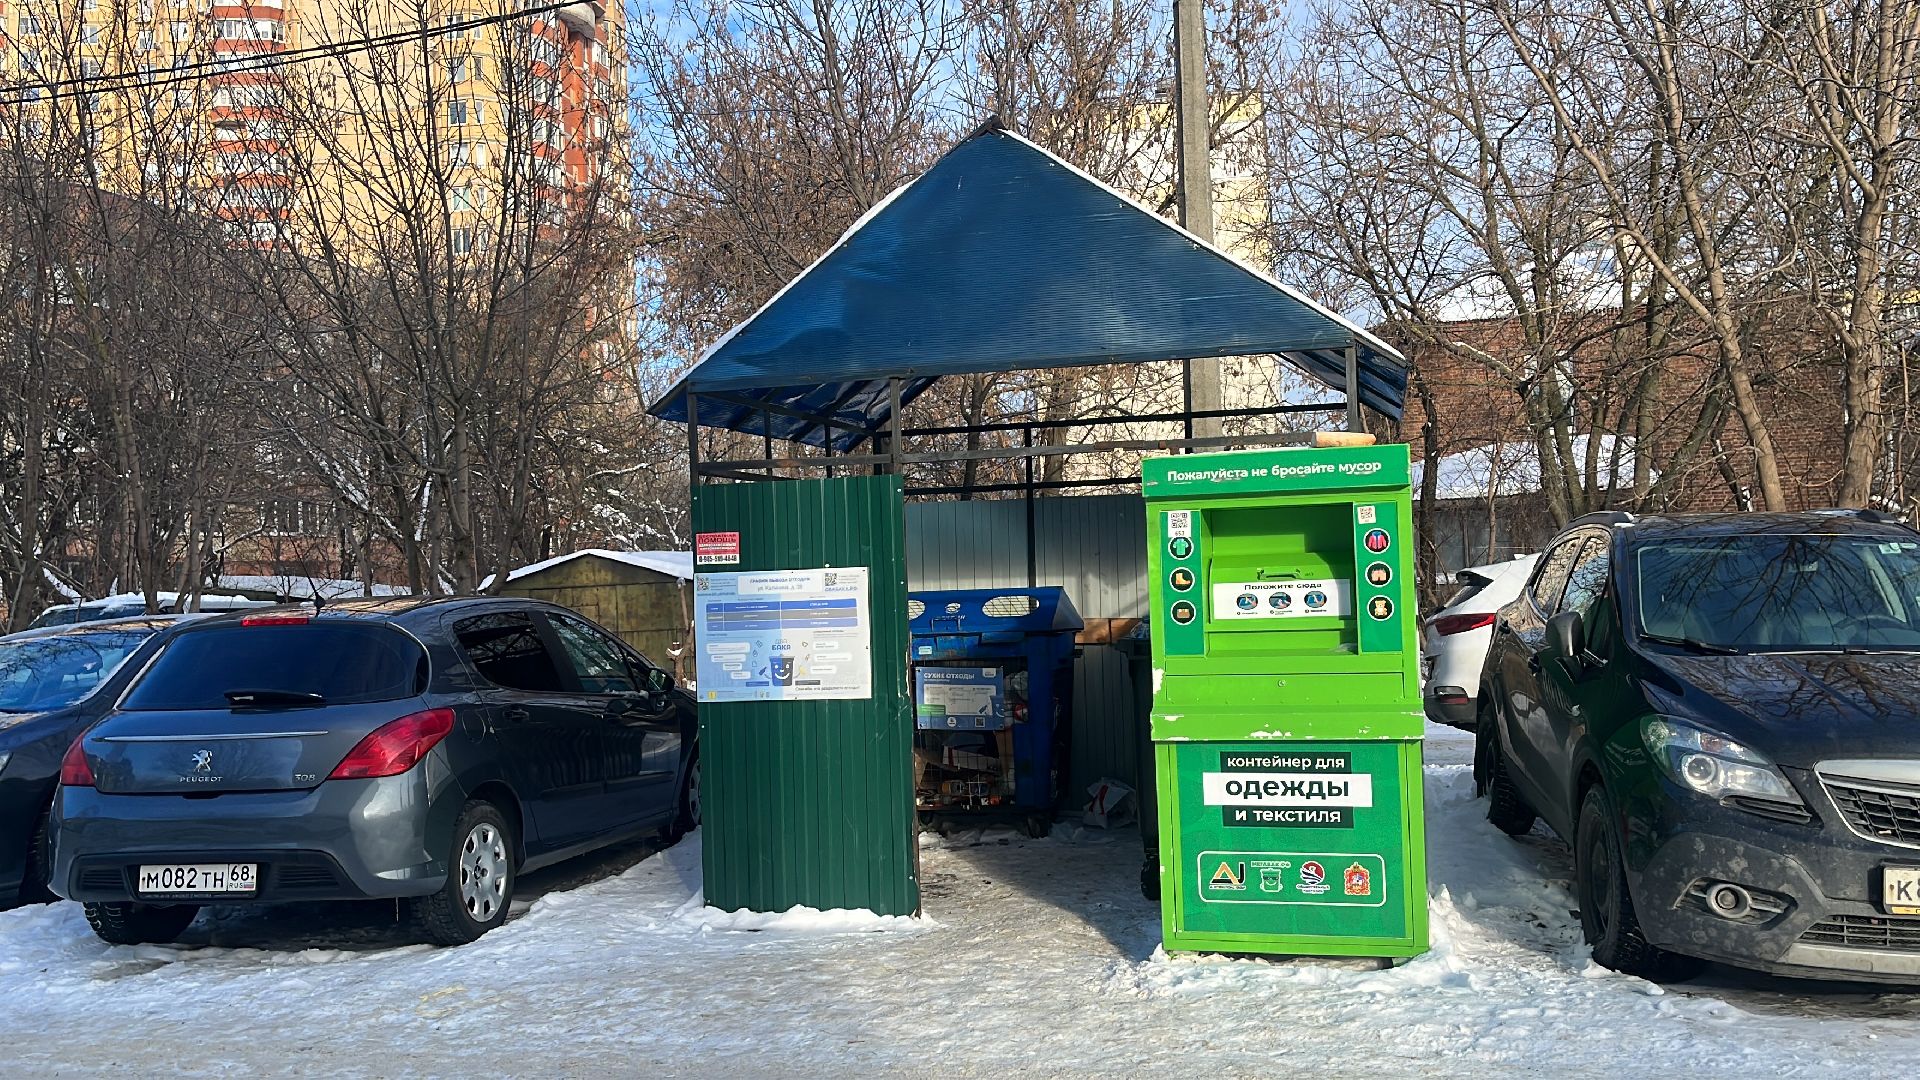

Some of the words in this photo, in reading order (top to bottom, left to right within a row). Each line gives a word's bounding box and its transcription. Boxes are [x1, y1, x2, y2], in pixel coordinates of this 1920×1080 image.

[1168, 468, 1248, 482] Пожалуйста
[1251, 467, 1268, 477] не
[1271, 463, 1334, 478] бросайте
[1338, 461, 1381, 475] мусор
[1244, 583, 1294, 591] Положите
[945, 672, 975, 680] ОТХОДЫ
[1227, 756, 1312, 770] контейнер
[1315, 757, 1345, 770] для
[294, 773, 316, 782] 308
[1225, 780, 1349, 800] одежды
[1235, 811, 1247, 822] и
[1253, 810, 1341, 823] текстиля
[230, 865, 250, 882] 68
